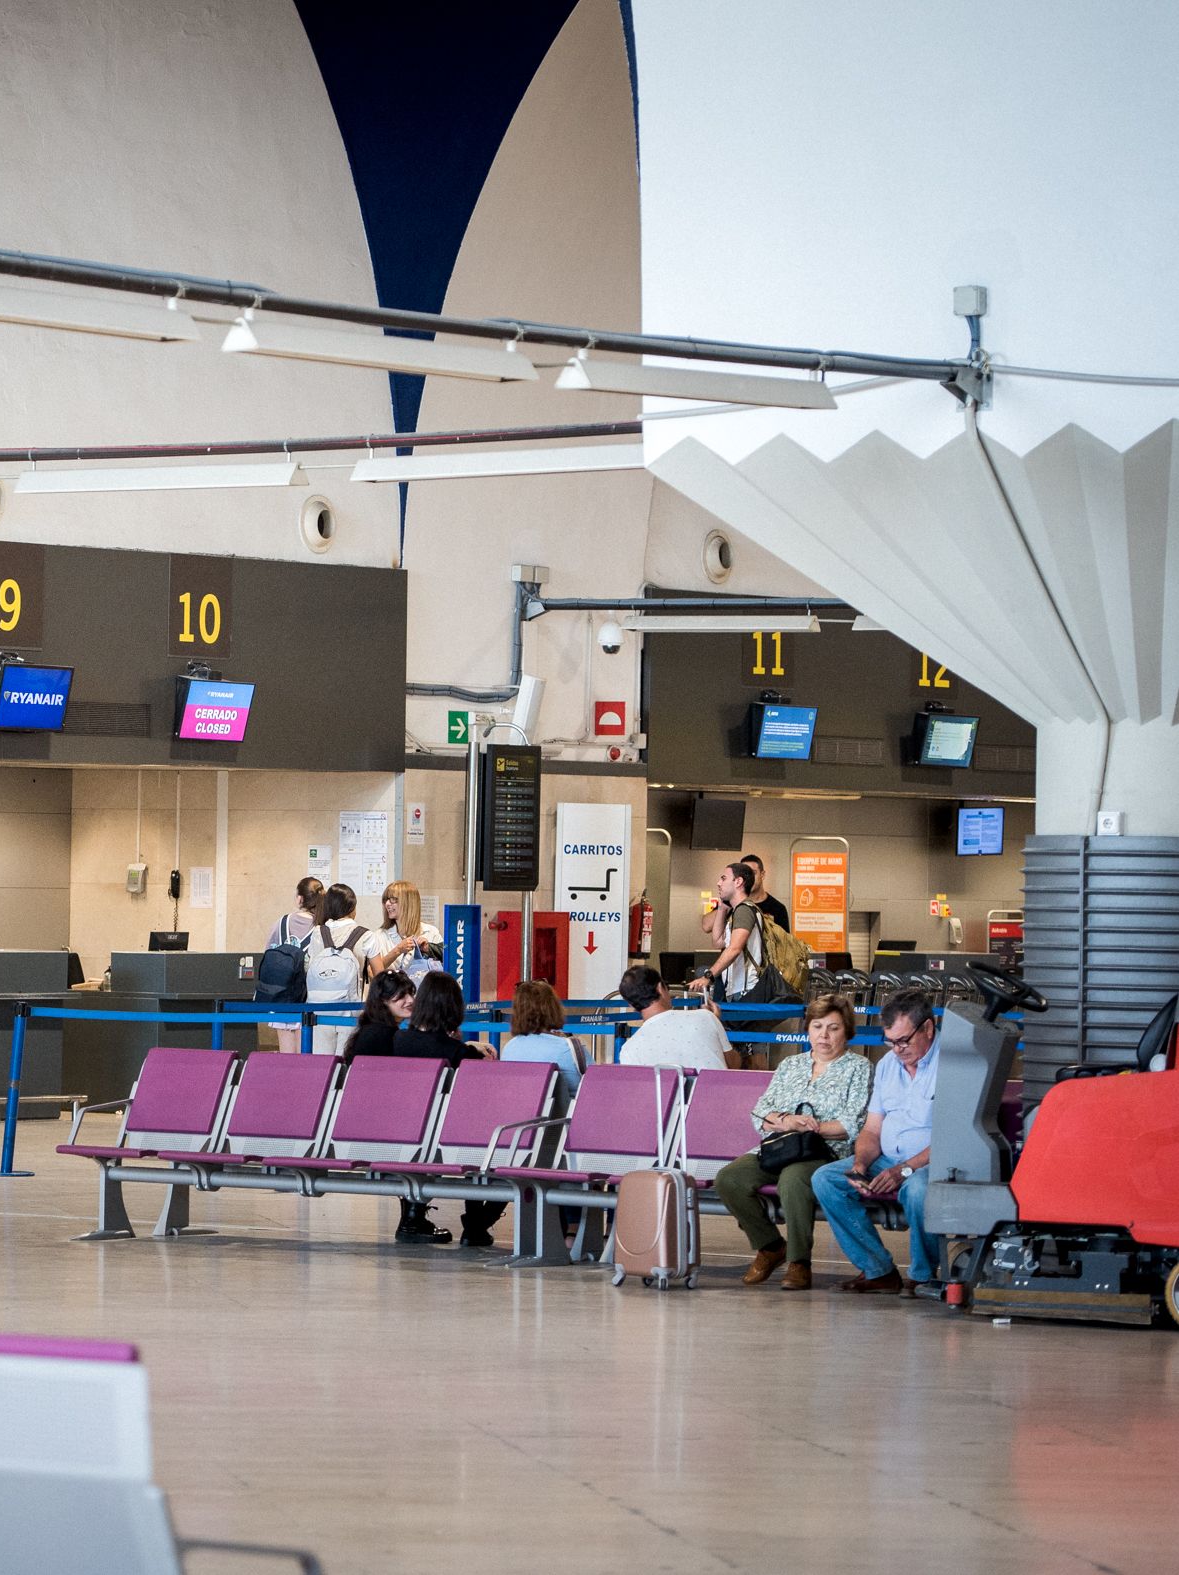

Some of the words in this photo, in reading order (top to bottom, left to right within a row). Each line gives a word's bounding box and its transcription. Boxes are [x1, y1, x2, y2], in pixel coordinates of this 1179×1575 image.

[179, 592, 221, 645] 10
[752, 632, 785, 676] 11
[9, 691, 64, 706] RYANAIR
[210, 691, 234, 699] RYANAIR
[194, 708, 238, 721] CERRADO
[195, 722, 231, 735] CLOSED
[563, 844, 623, 856] CARRITOS
[569, 911, 621, 922] ROLLEYS
[456, 920, 465, 990] ANAIR
[775, 1033, 810, 1042] RYANAI
